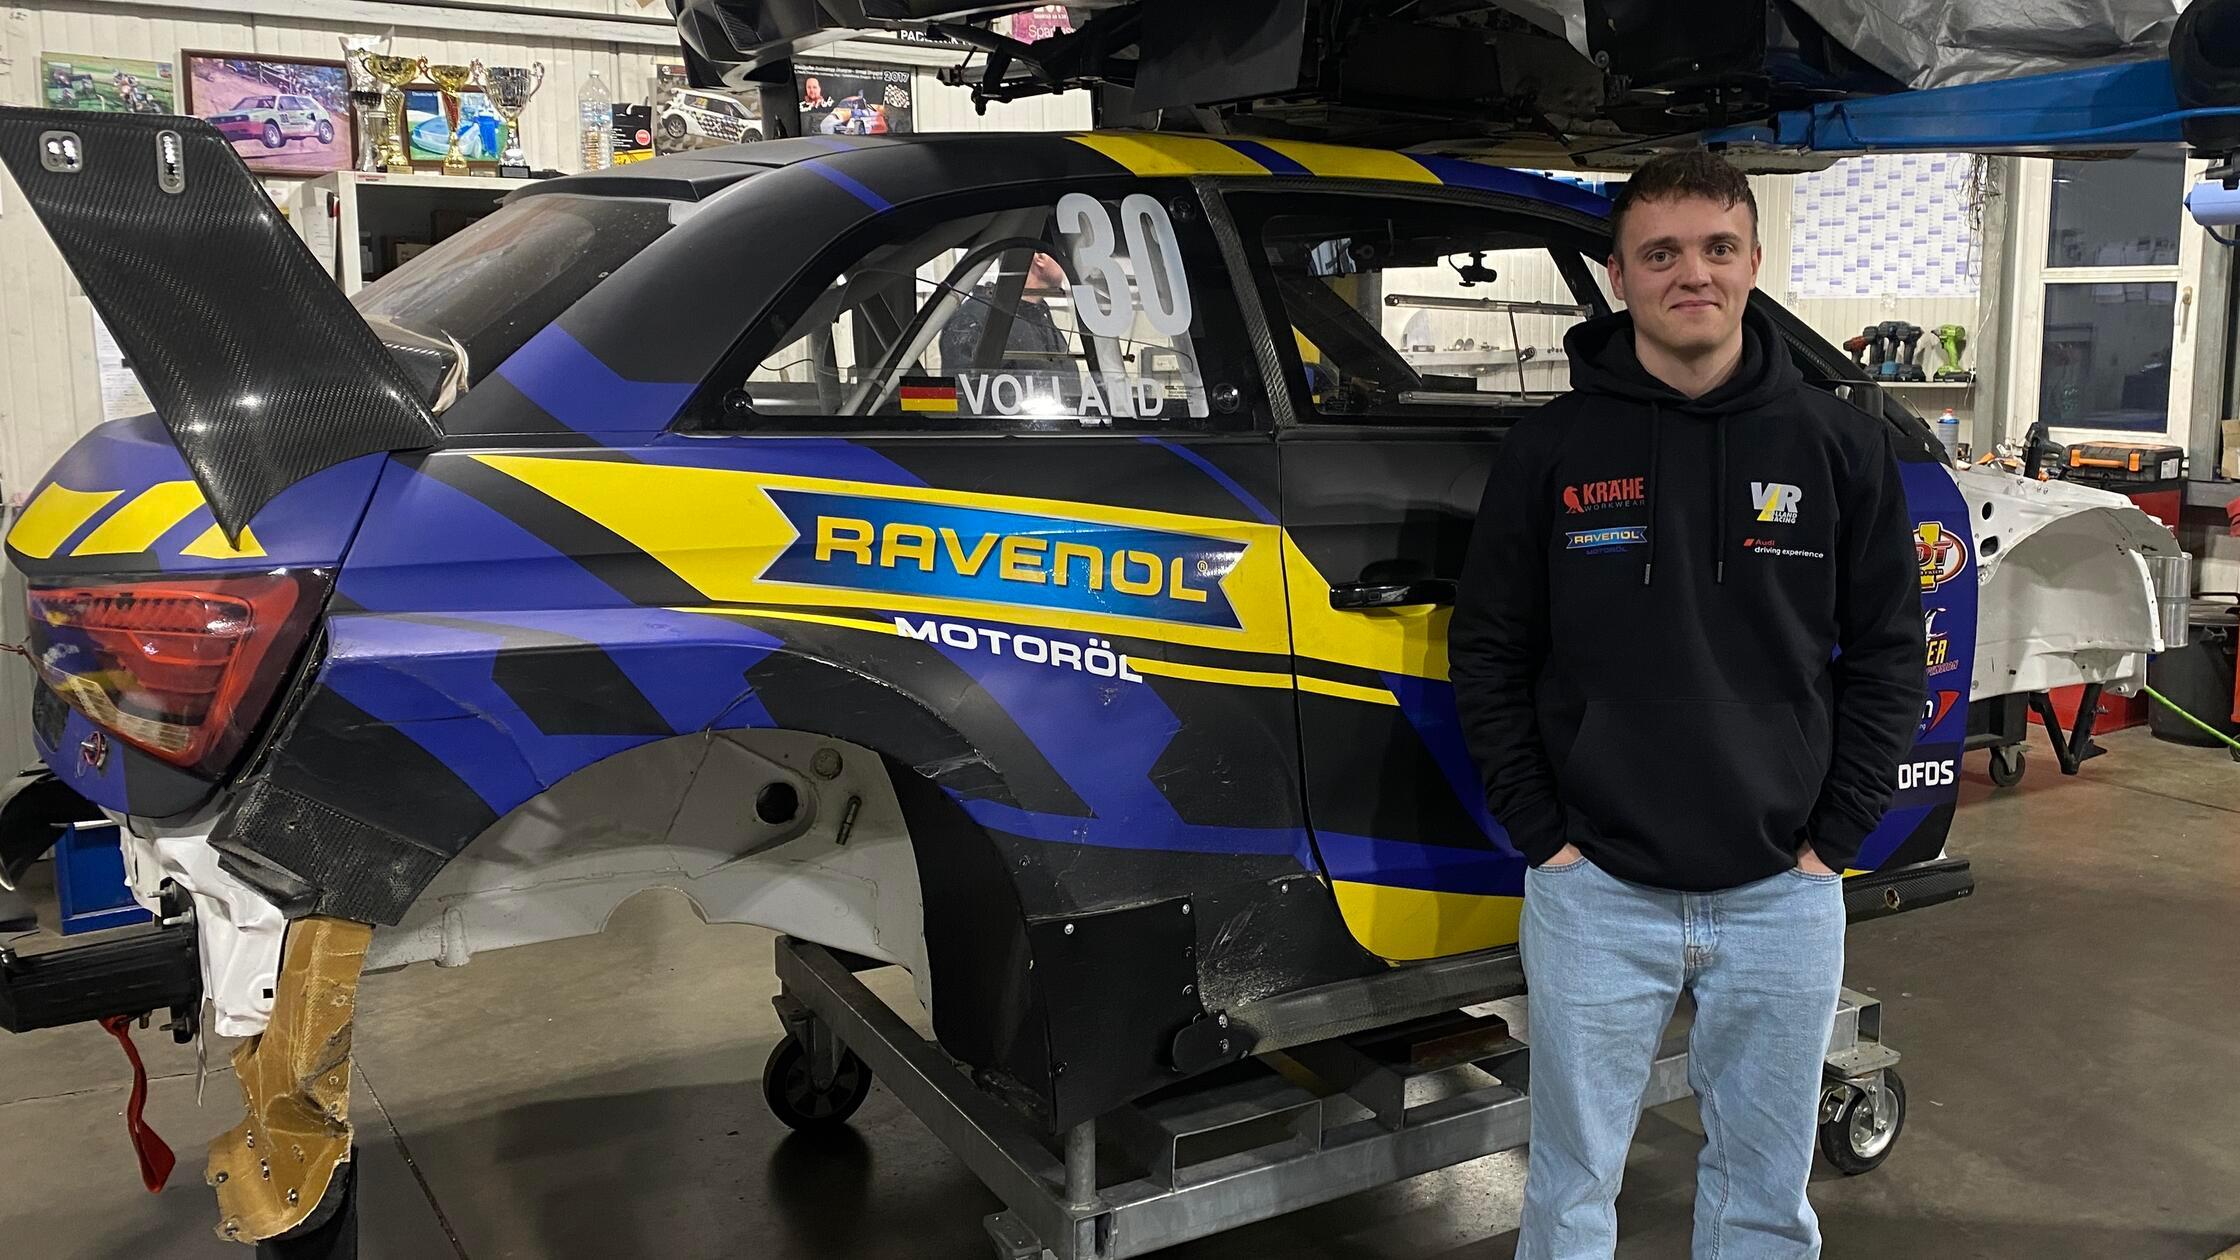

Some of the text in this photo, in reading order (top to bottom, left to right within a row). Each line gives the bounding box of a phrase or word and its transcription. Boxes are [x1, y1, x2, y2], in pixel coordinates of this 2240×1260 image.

[884, 71, 910, 83] 2017
[1056, 192, 1192, 337] 30
[1583, 477, 1644, 505] KRÄHE
[1584, 500, 1645, 512] WORKWEAR
[1574, 531, 1640, 544] RAVENOL
[815, 515, 1208, 603] RAVENOL
[1754, 546, 1824, 559] driving experience
[894, 616, 1143, 684] MOTORÖL
[1898, 760, 1954, 790] DFDS
